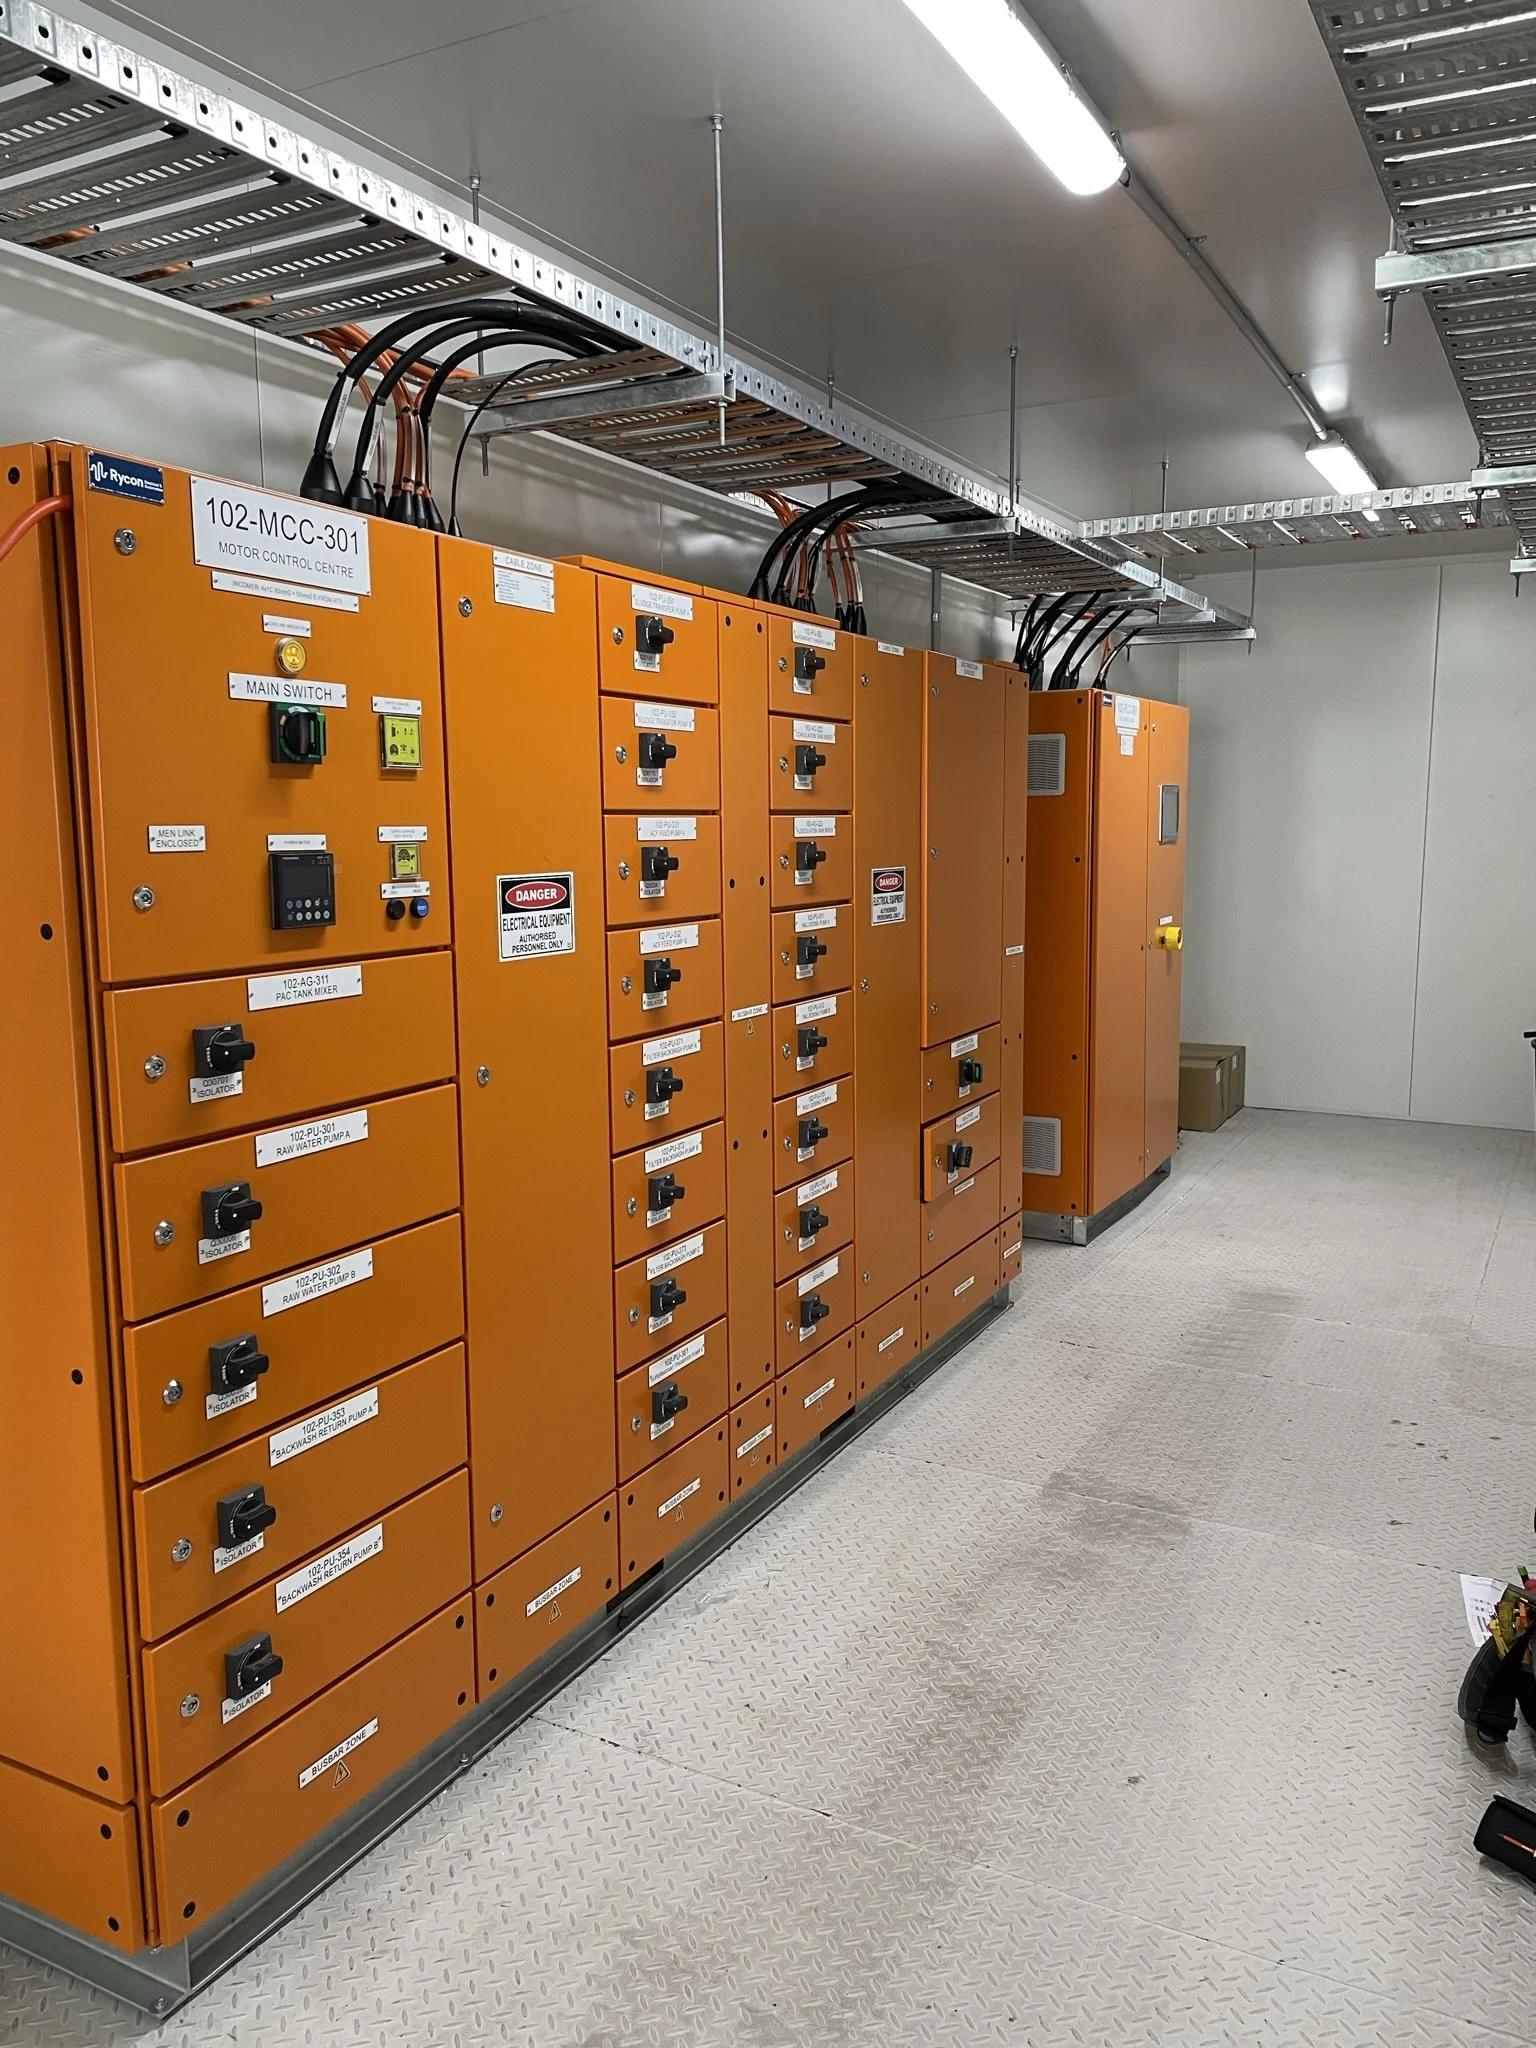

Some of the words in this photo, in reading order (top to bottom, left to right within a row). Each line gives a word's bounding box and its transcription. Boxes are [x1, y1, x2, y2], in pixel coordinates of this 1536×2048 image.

[110, 469, 144, 488] Rycon
[207, 497, 359, 555] 102-MCC-301
[219, 541, 260, 560] MOTOR
[262, 551, 313, 570] CONTROL
[315, 561, 354, 579] CENTRE
[505, 557, 525, 568] CABLE
[526, 561, 543, 572] ZONE
[246, 680, 279, 696] MAIN
[283, 684, 332, 701] SWITCH
[156, 839, 199, 848] ENCLOSED
[158, 829, 176, 838] MEN
[177, 829, 196, 838] LINK
[880, 878, 898, 887] DANGER
[516, 889, 557, 902] DANGER
[503, 916, 538, 932] ELECTRICAL
[539, 912, 571, 928] EQUIPMENT
[512, 943, 548, 954] PERSONNEL
[549, 940, 564, 949] ONLY
[519, 931, 557, 943] AUTHORISED
[276, 992, 292, 1001] PAC
[293, 989, 314, 999] TANK
[315, 985, 338, 996] MIXER
[283, 975, 329, 990] 102-AG-311
[737, 1010, 752, 1018] BUSBAR
[647, 1053, 660, 1061] FILTER
[661, 1048, 683, 1057] BACKWASH
[197, 1084, 236, 1098] ISOLATOR
[290, 1123, 335, 1142] 102-PU-301
[276, 1145, 296, 1157] RAW
[297, 1139, 322, 1152] WATER
[324, 1133, 345, 1146] PUMP
[345, 1131, 351, 1139] A
[649, 1158, 662, 1169] FILTER
[663, 1152, 685, 1164] BACKWASH
[685, 1147, 696, 1155] PUMP
[205, 1241, 243, 1258] ISOLATOR
[650, 1264, 664, 1275] FILTER
[664, 1254, 686, 1269] BACKWASH
[686, 1249, 697, 1258] PUMP
[296, 1265, 341, 1289] 102-PU-302
[813, 1270, 825, 1282] SPARE
[282, 1292, 300, 1304] RAW
[302, 1283, 327, 1297] WATER
[329, 1275, 350, 1288] PUMP
[351, 1270, 356, 1279] B
[213, 1392, 250, 1413] ISOLATOR
[302, 1408, 346, 1435] 102-PU-353
[276, 1434, 317, 1459] BACKWASH
[318, 1420, 347, 1437] RETURN
[348, 1410, 367, 1426] PUMP
[368, 1406, 374, 1414] A
[742, 1438, 757, 1453] BUSBAR
[757, 1430, 768, 1444] ZONE
[664, 1493, 683, 1512] BUSBAR
[683, 1485, 695, 1499] ZONE
[221, 1542, 257, 1567] ISOLATOR
[307, 1547, 351, 1578] 102-PU-354
[282, 1578, 323, 1605] BACKWASH
[324, 1558, 352, 1582] RETURN
[354, 1546, 373, 1563] PUMP
[373, 1541, 379, 1550] B
[535, 1583, 557, 1608] BUSBAR
[558, 1575, 574, 1591] ZONE
[229, 1689, 265, 1716] ISOLATOR
[311, 1745, 344, 1777] BUSBAR
[345, 1730, 367, 1751] ZONE
